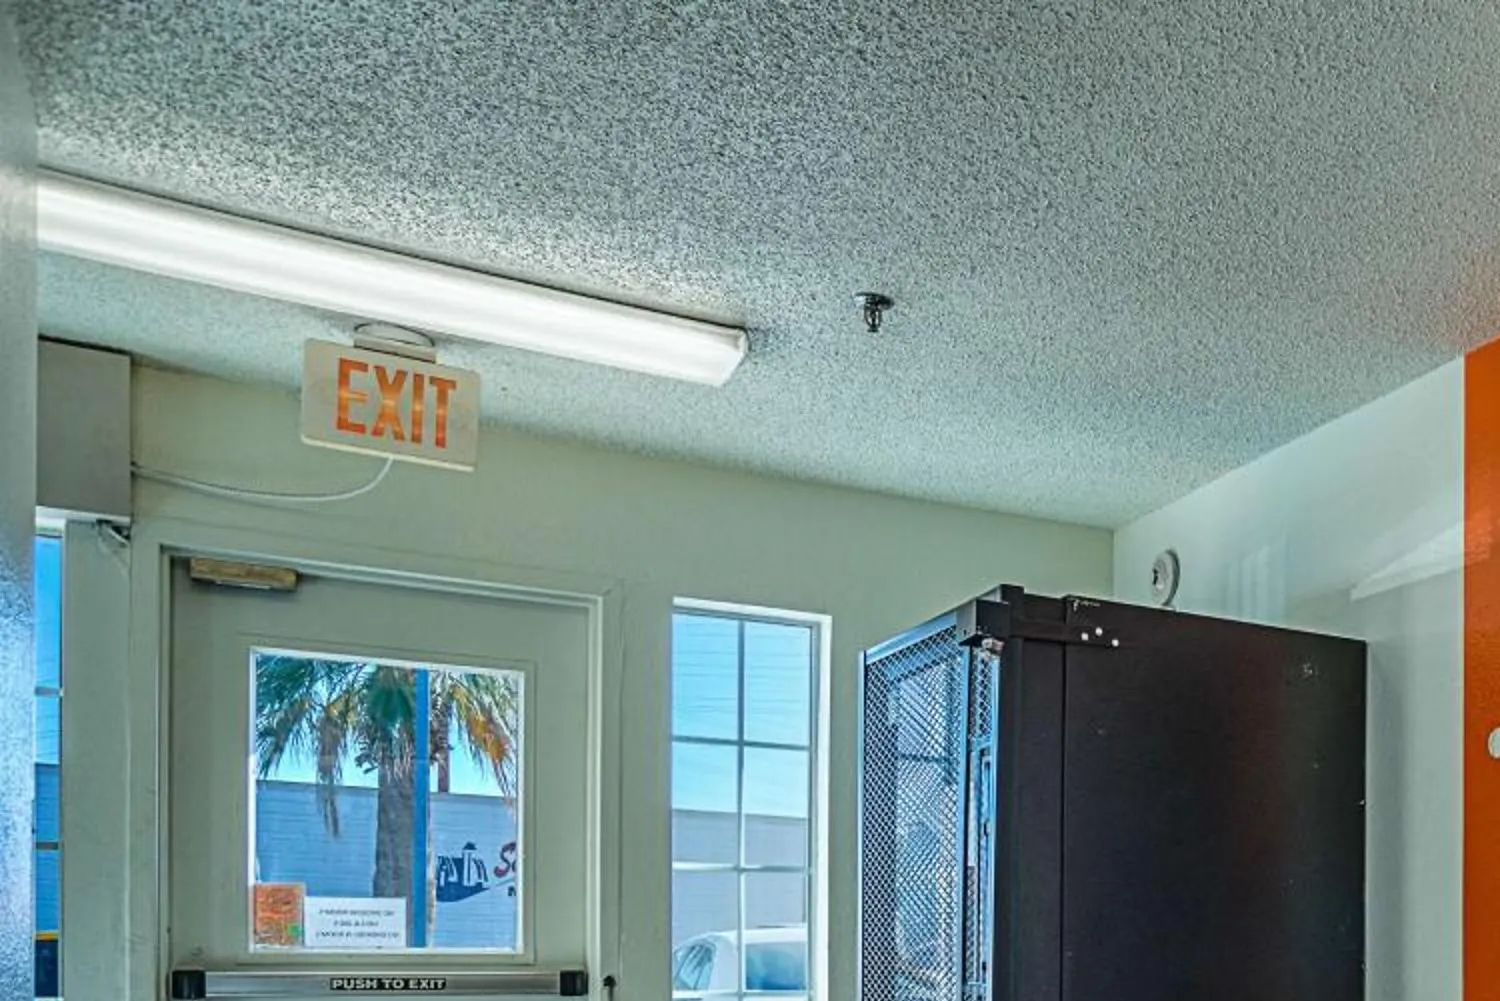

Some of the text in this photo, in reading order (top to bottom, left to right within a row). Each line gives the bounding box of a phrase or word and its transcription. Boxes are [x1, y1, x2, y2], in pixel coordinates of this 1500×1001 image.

[336, 357, 457, 449] EXIT
[332, 978, 446, 989] PUSH TO EXIT
